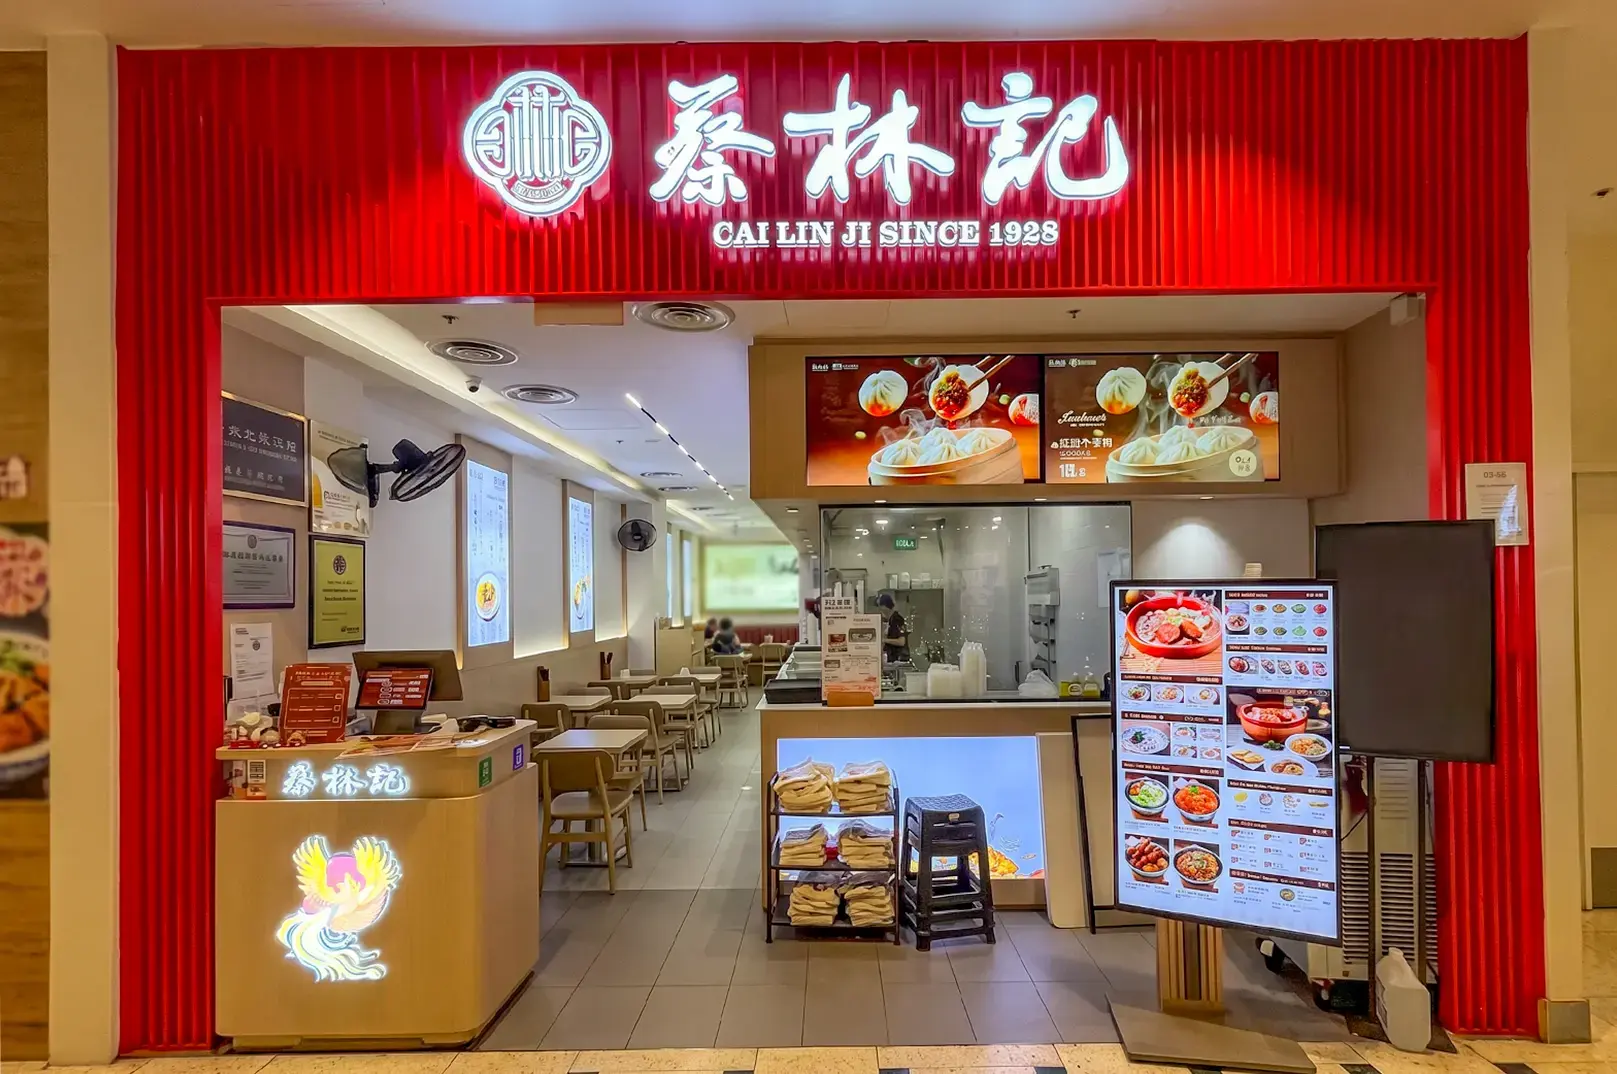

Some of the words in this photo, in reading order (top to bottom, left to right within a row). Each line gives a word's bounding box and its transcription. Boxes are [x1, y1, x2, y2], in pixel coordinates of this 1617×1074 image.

[650, 72, 1129, 206] 蔡林記
[712, 220, 770, 248] CAI
[776, 221, 834, 247] LIN
[841, 221, 872, 247] JI
[879, 220, 980, 248] SINCE
[989, 220, 1059, 247] 1928
